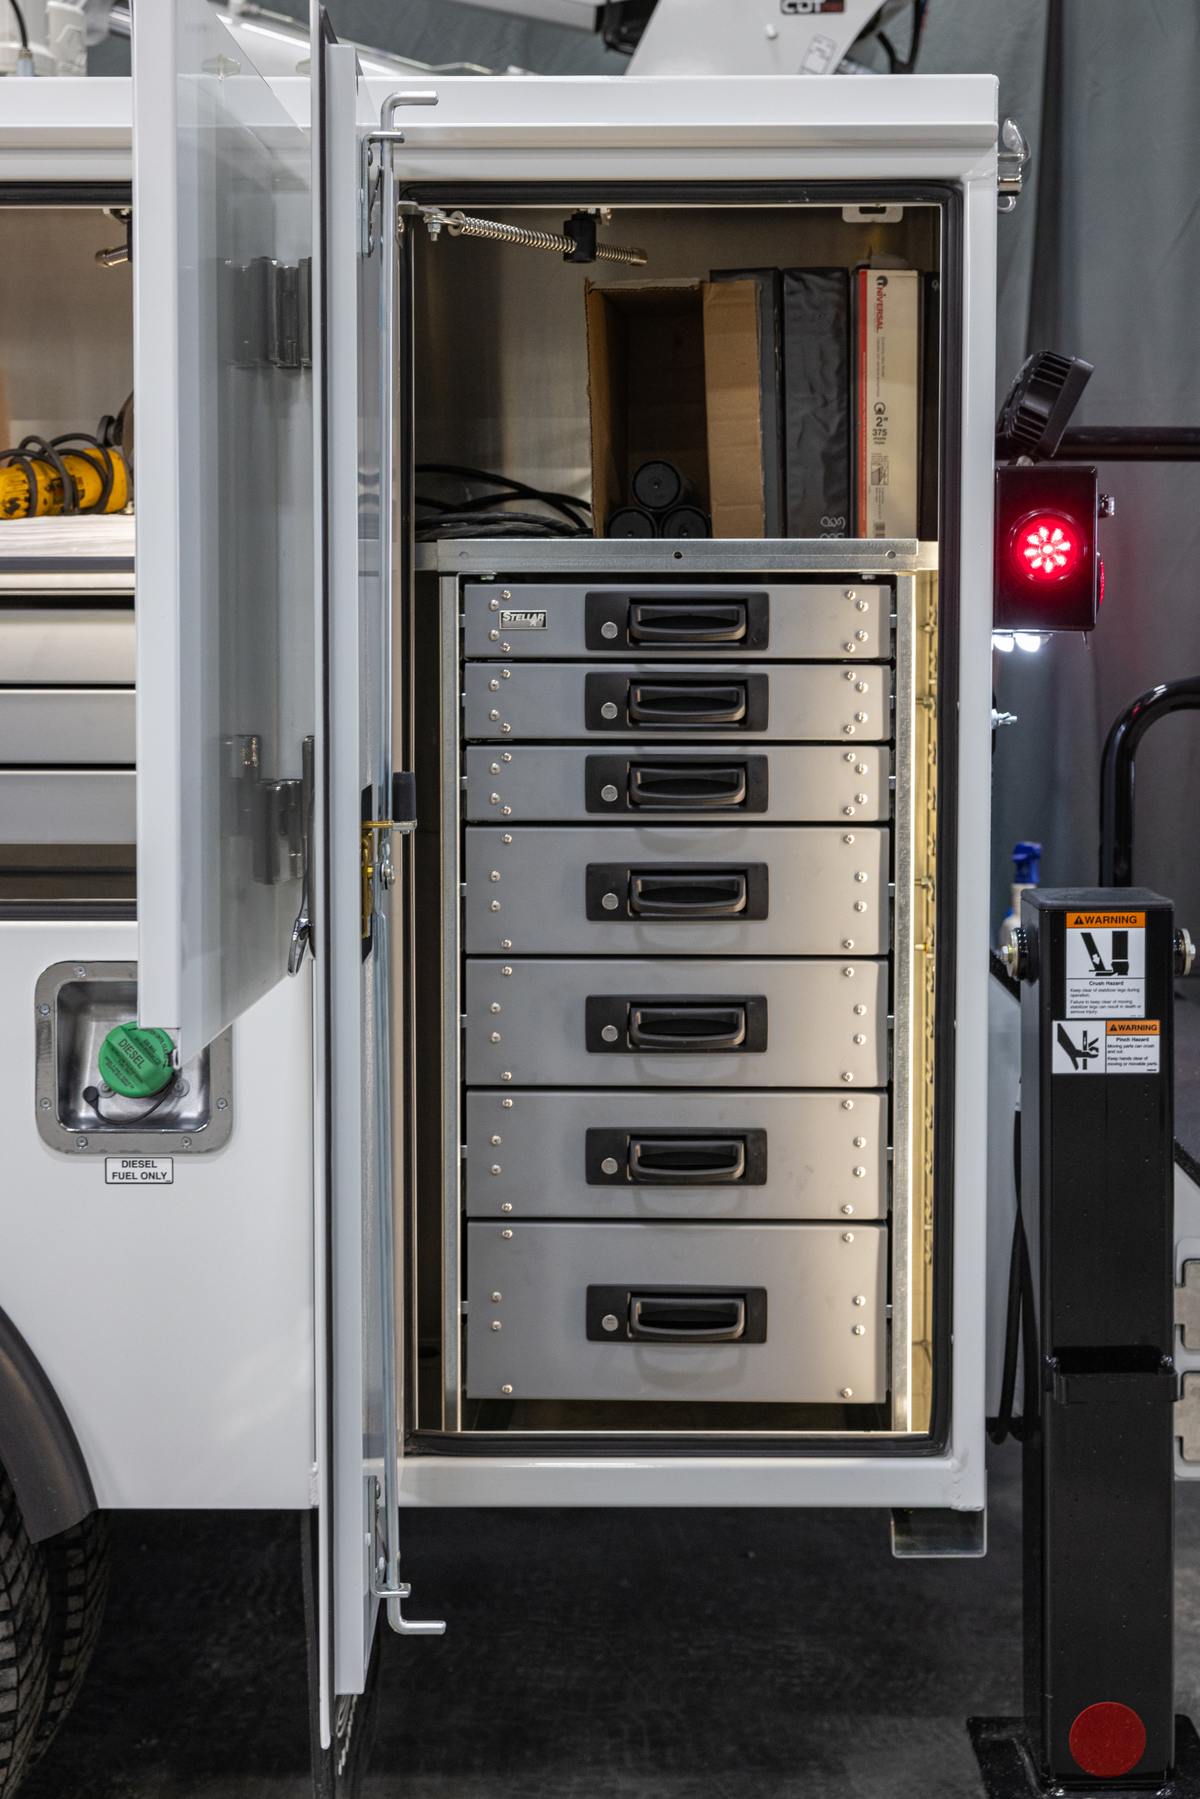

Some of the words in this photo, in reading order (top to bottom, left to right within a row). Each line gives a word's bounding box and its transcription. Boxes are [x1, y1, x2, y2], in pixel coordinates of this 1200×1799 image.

[872, 428, 887, 436] 375
[502, 612, 545, 621] STELLAR
[1084, 915, 1137, 924] WARNING
[118, 1038, 145, 1069] DIESEL
[122, 1160, 157, 1168] DIESEL
[112, 1172, 138, 1180] FUEL
[141, 1172, 167, 1180] ONLY
